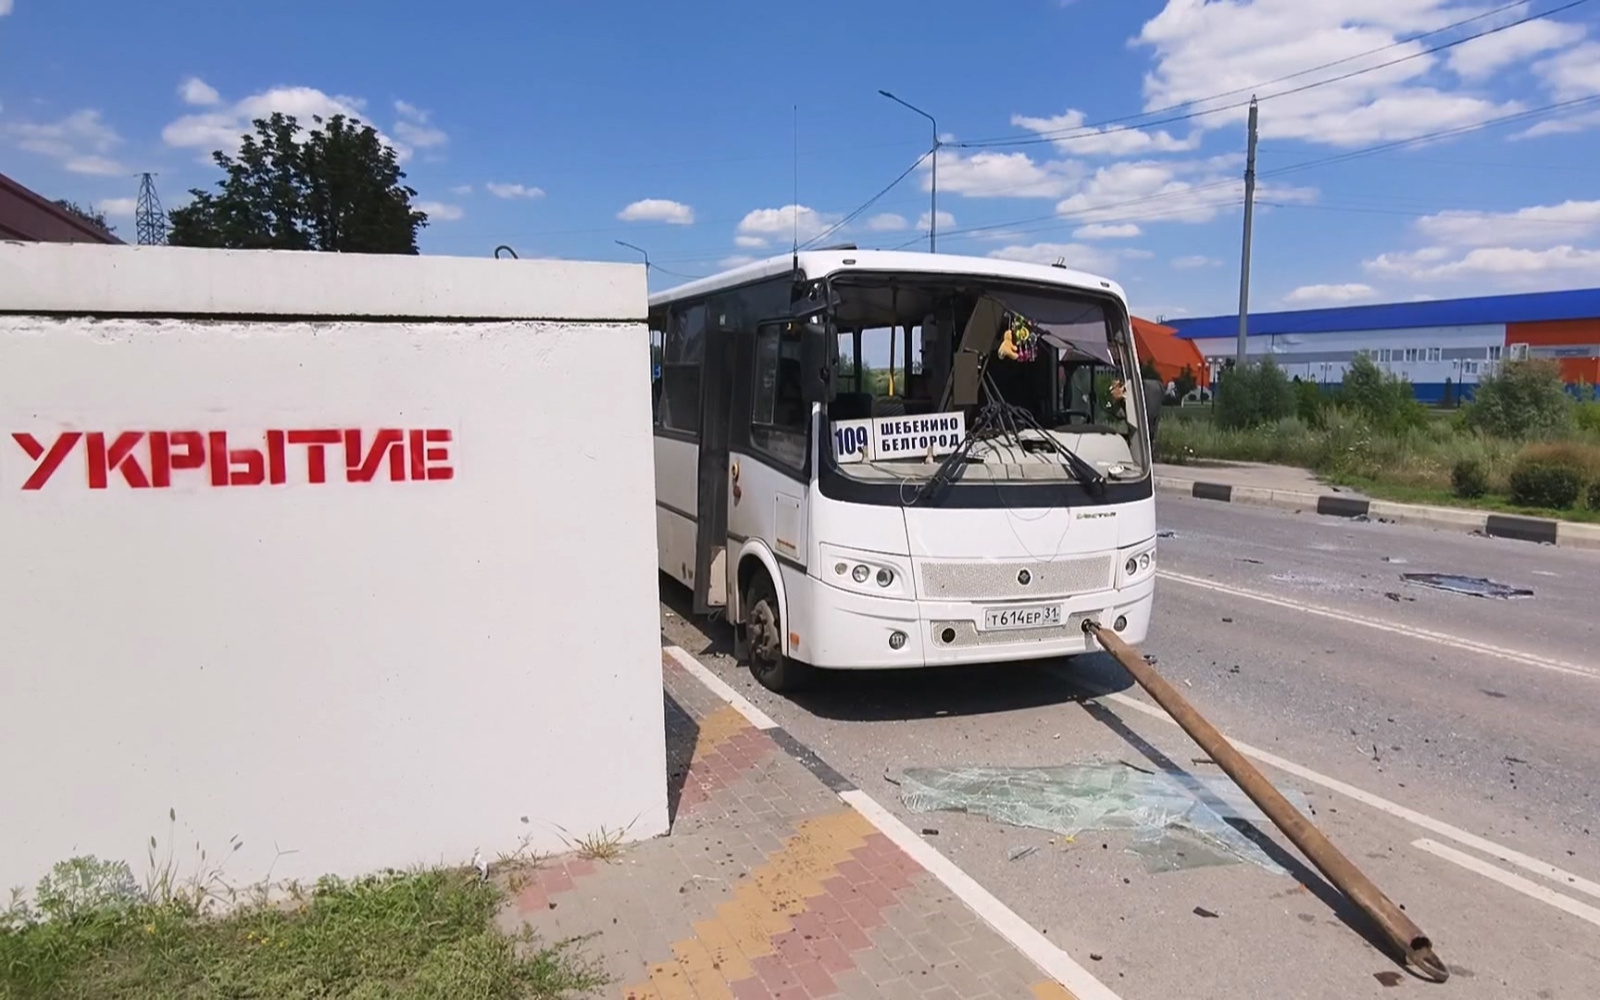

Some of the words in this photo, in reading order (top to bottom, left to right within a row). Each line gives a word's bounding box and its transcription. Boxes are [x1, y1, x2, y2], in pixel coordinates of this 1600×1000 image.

[881, 417, 959, 436] ШЕБЕКИНО
[835, 426, 868, 456] 109
[882, 434, 960, 452] БЕЛГОРОД
[11, 427, 454, 490] УКРЫТИЕ
[991, 610, 1041, 626] Т614ЕР
[1044, 607, 1057, 619] 31
